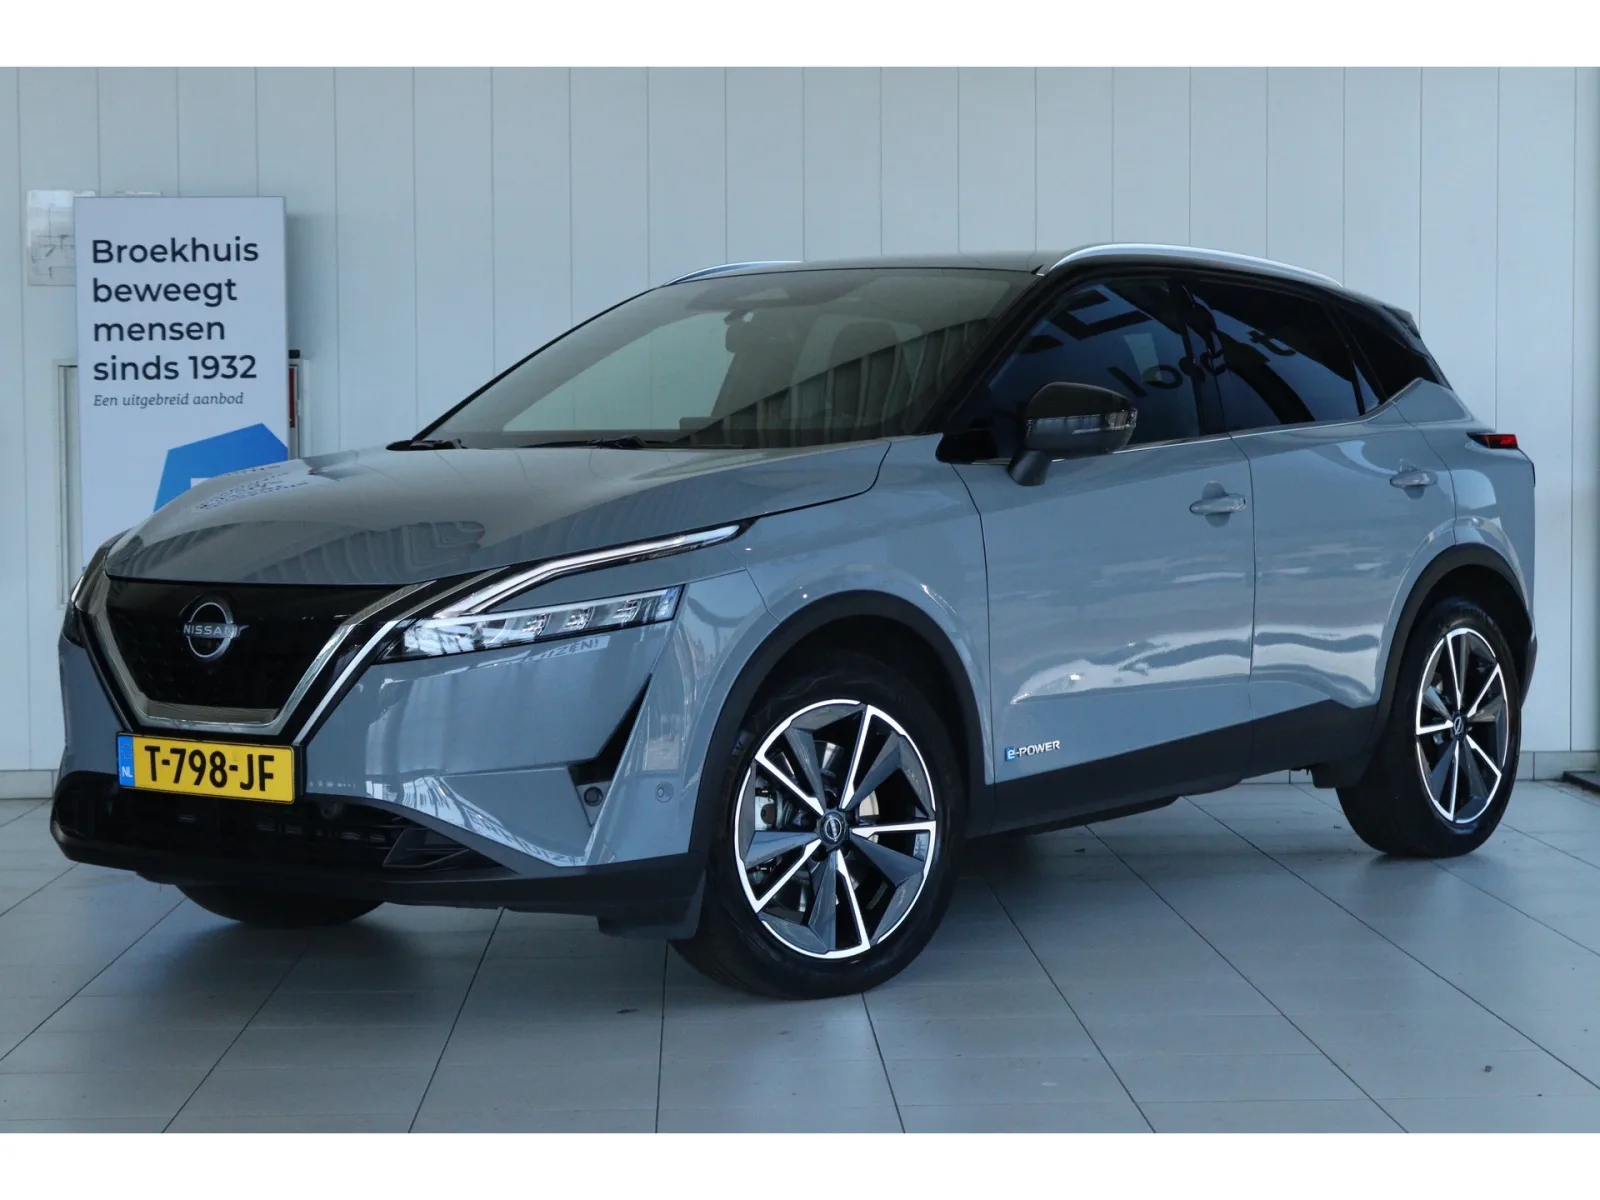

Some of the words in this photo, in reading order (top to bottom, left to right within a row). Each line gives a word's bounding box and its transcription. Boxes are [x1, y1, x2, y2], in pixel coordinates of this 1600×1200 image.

[92, 236, 259, 263] Broekhuis
[93, 278, 237, 307] beweegt
[94, 322, 225, 341] mensen
[94, 355, 179, 381] sinds
[188, 355, 257, 379] 1932
[94, 395, 118, 406] Een
[123, 393, 189, 409] uitgebreid
[193, 392, 243, 405] aanbod
[183, 624, 238, 637] NISSAN
[121, 766, 133, 778] NL
[144, 745, 275, 791] T-798-JF
